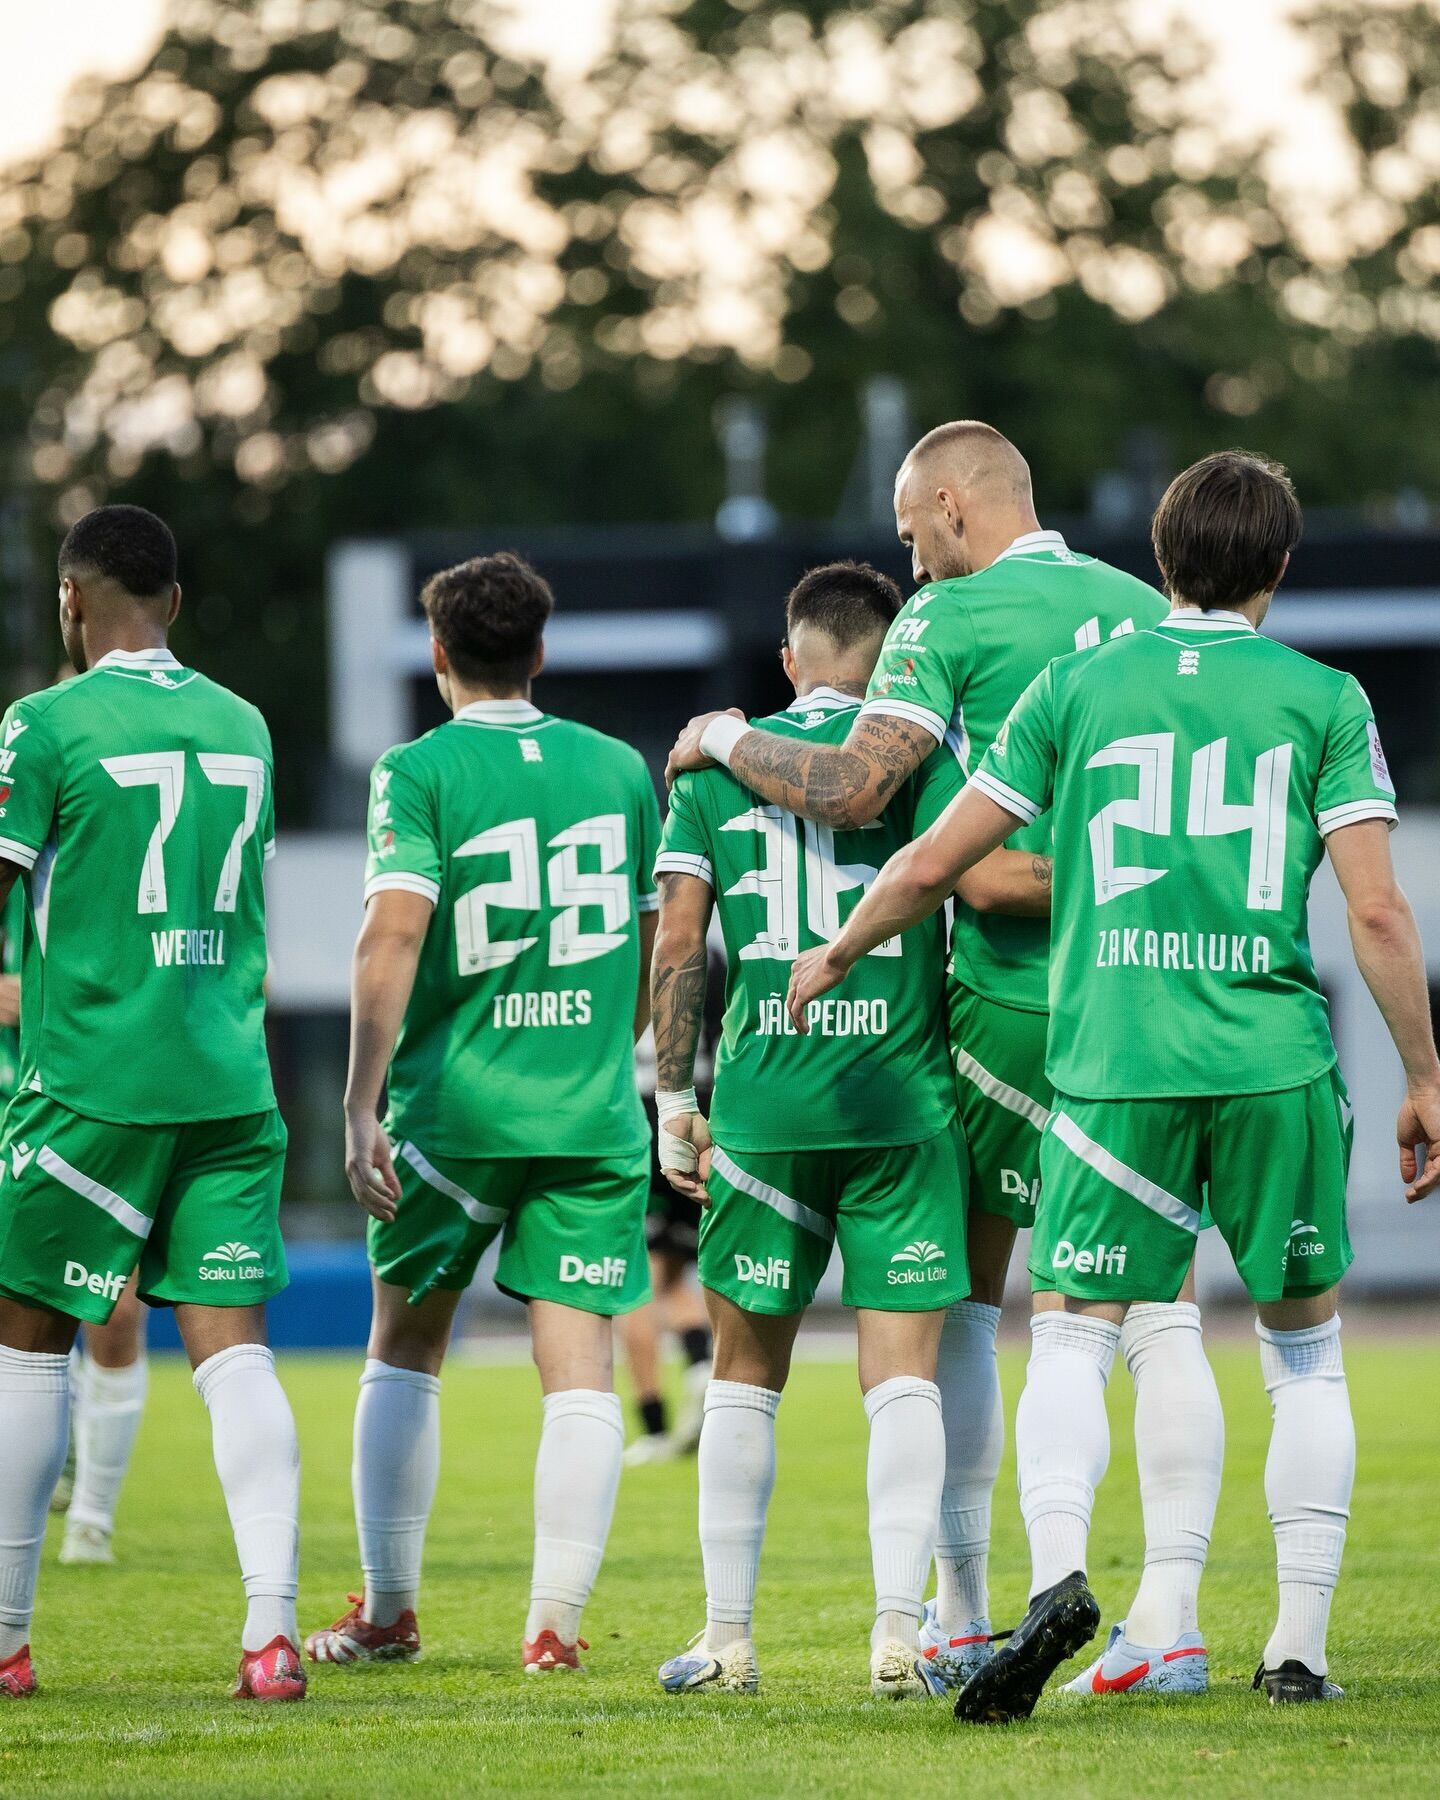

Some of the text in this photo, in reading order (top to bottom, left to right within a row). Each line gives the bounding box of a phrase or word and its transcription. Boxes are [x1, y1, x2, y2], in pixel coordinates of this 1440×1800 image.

[890, 618, 931, 642] FH
[0, 747, 17, 774] H
[99, 750, 265, 914] 77
[1084, 732, 1293, 911] 24
[451, 813, 631, 976] 28
[151, 929, 225, 967] WENDELL
[1096, 928, 1270, 973] ZAKARLIUKA
[493, 989, 592, 1029] TORRES
[806, 999, 888, 1037] PEDRO
[1000, 1168, 1040, 1206] Del
[1052, 1240, 1127, 1275] Delfi
[1292, 1242, 1325, 1257] Läte
[63, 1260, 128, 1301] Delf
[198, 1266, 265, 1281] Saku Läte
[559, 1255, 627, 1287] Delfi
[734, 1254, 790, 1290] Delfi
[887, 1266, 947, 1285] Saku Läte
